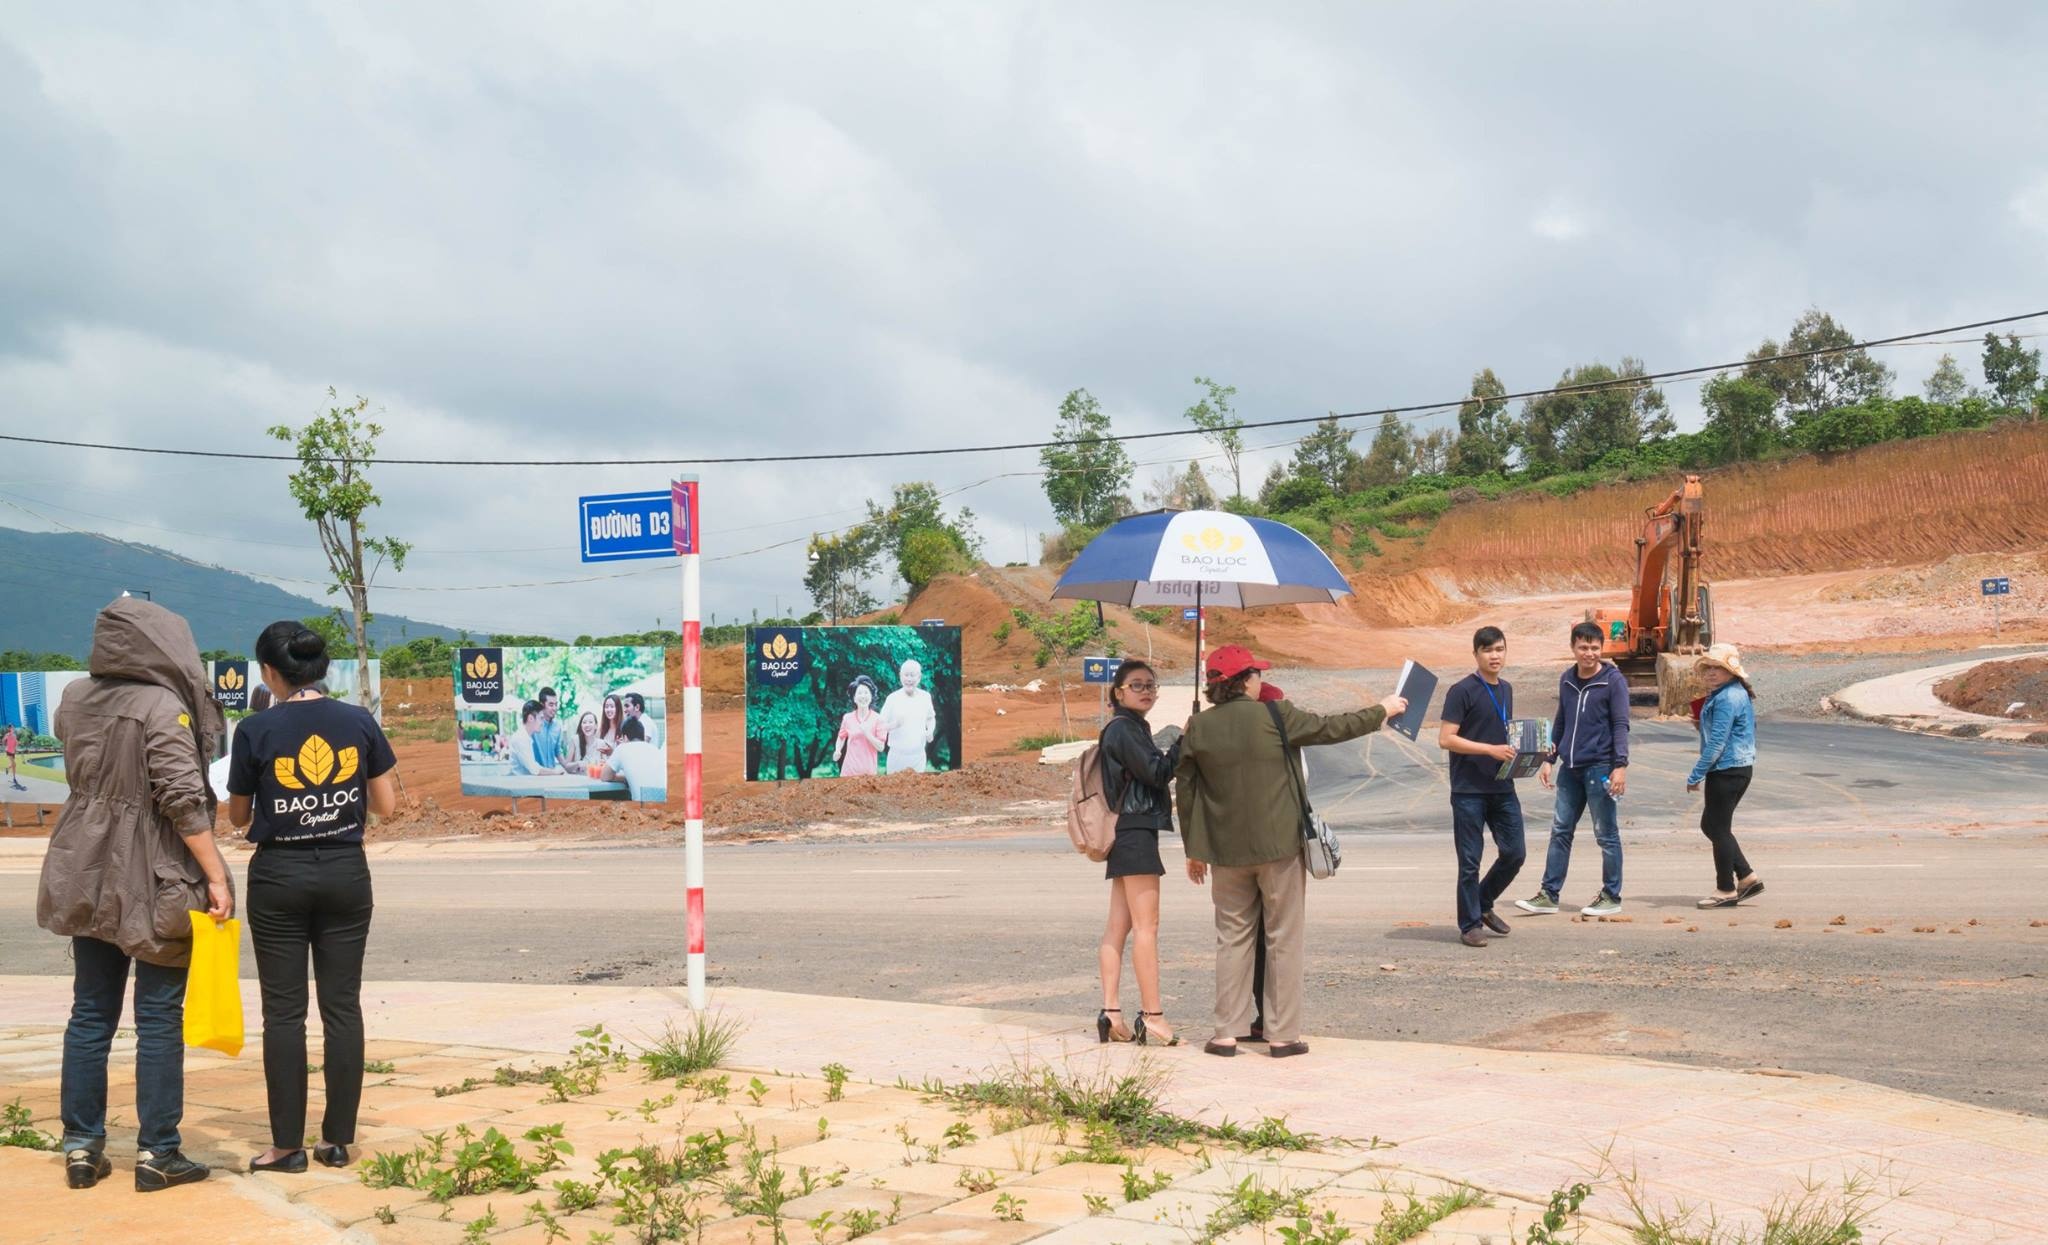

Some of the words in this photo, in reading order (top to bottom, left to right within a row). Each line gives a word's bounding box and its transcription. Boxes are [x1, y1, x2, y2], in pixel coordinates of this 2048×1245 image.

[591, 509, 642, 540] ĐƯỜNG
[649, 511, 671, 536] D3
[1181, 555, 1213, 565] BAO
[1217, 556, 1248, 566] LOC
[761, 662, 780, 670] BAO
[781, 661, 799, 670] LOC
[466, 681, 482, 689] BAO
[483, 681, 499, 689] LOC
[217, 692, 231, 700] BAO
[232, 692, 244, 700] LOC
[274, 794, 319, 814] BAO
[322, 787, 359, 808] LOC
[299, 808, 340, 827] Capital
